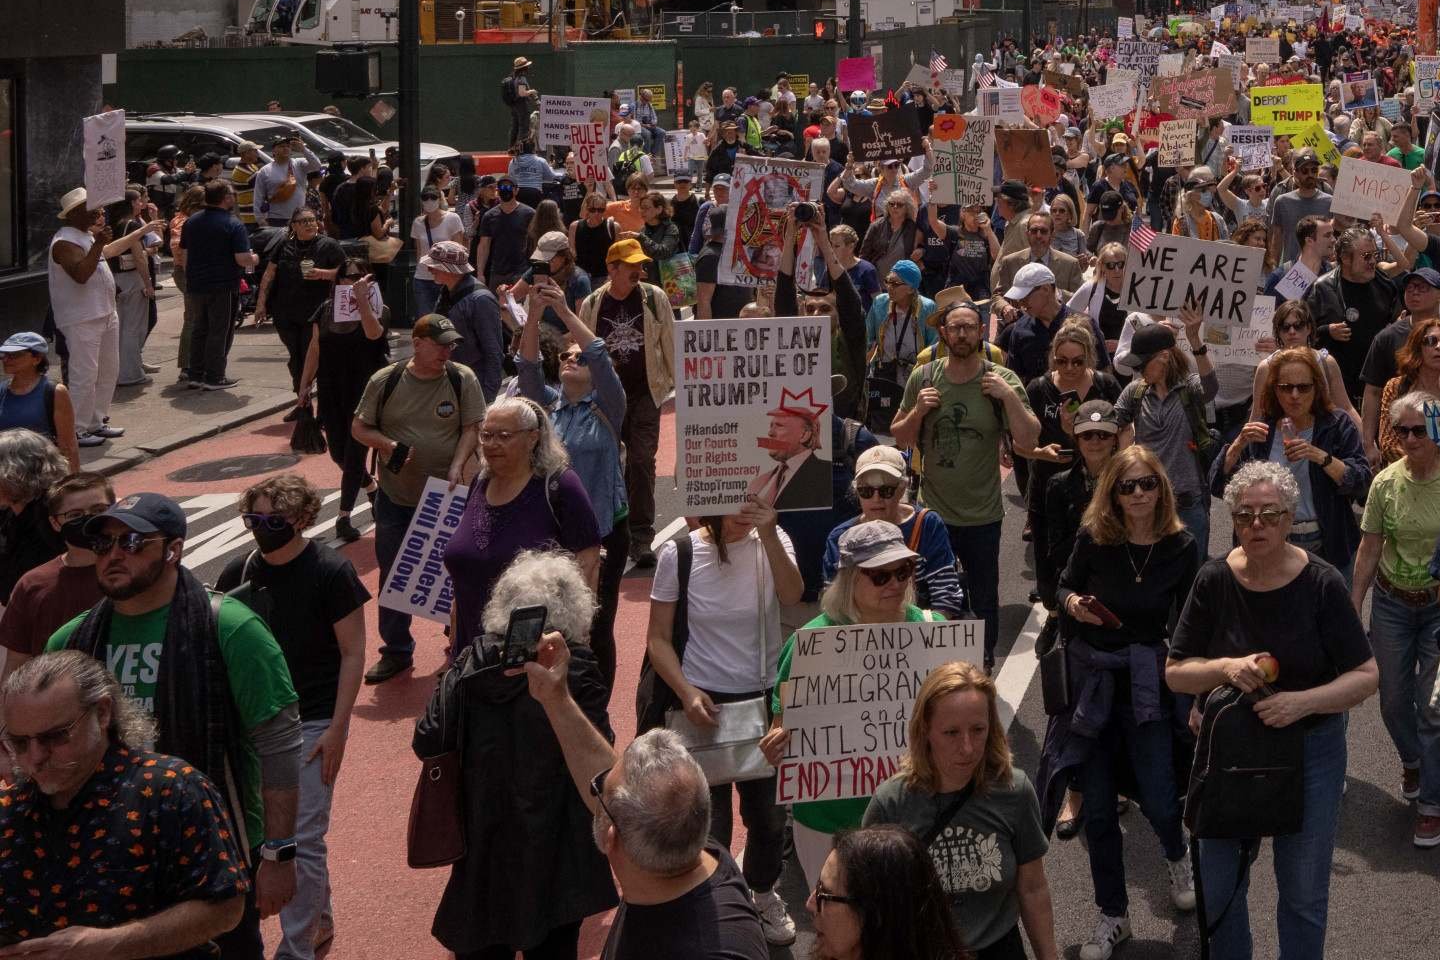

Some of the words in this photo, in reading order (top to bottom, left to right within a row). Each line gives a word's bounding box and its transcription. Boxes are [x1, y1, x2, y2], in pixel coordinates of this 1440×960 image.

[1144, 63, 1159, 76] NOT
[1253, 94, 1288, 107] DEPORT
[545, 108, 585, 117] MIGRANTS
[1272, 110, 1313, 122] TRUMP
[570, 123, 604, 145] RULE
[972, 133, 986, 142] not
[1161, 133, 1193, 141] Never
[1231, 134, 1271, 144] RESIST
[862, 141, 888, 150] FOSSIL
[890, 136, 912, 147] FUELS
[954, 141, 985, 156] healthy
[1160, 139, 1194, 151] Abduct
[579, 145, 596, 165] OF
[865, 149, 881, 158] OUT
[895, 146, 912, 155] NYC
[933, 161, 952, 172] and
[956, 163, 981, 175] other
[936, 153, 949, 164] for
[955, 154, 984, 168] children
[576, 164, 607, 182] LAW
[751, 163, 769, 174] NO
[772, 165, 810, 178] KINGS
[957, 174, 983, 193] living
[1352, 175, 1406, 205] MARS
[957, 189, 987, 205] things
[1140, 246, 1178, 272] WE
[1190, 252, 1248, 284] ARE
[735, 274, 753, 285] NO
[1127, 271, 1247, 323] KILMAR
[684, 328, 738, 353] RULE
[744, 327, 770, 352] OF
[778, 326, 822, 350] LAW
[684, 356, 727, 380] NOT
[733, 353, 787, 379] RULE
[793, 352, 819, 376] OF
[684, 381, 768, 407] TRUMP!
[684, 422, 738, 437] #HandsOff
[685, 438, 701, 451] Our
[704, 437, 738, 449] Courts
[685, 453, 701, 465] Our
[705, 451, 737, 465] Rights
[686, 466, 702, 478] Our
[705, 464, 760, 477] Democracy
[686, 479, 748, 493] #StopTrump
[686, 493, 753, 507] #SaveAmeric
[415, 491, 445, 529] will
[442, 495, 466, 529] the
[386, 529, 431, 593] follow.
[410, 529, 453, 607] leaders
[796, 631, 826, 657] WE
[834, 626, 914, 653] STAND
[919, 623, 976, 649] WITH
[105, 642, 163, 684] YES
[863, 652, 911, 671] OUR
[123, 685, 136, 696] TO
[786, 669, 931, 709] IMMIGRAN
[860, 702, 909, 722] and
[782, 725, 858, 759] INTL.
[779, 760, 831, 801] END
[933, 844, 975, 857] POWER
